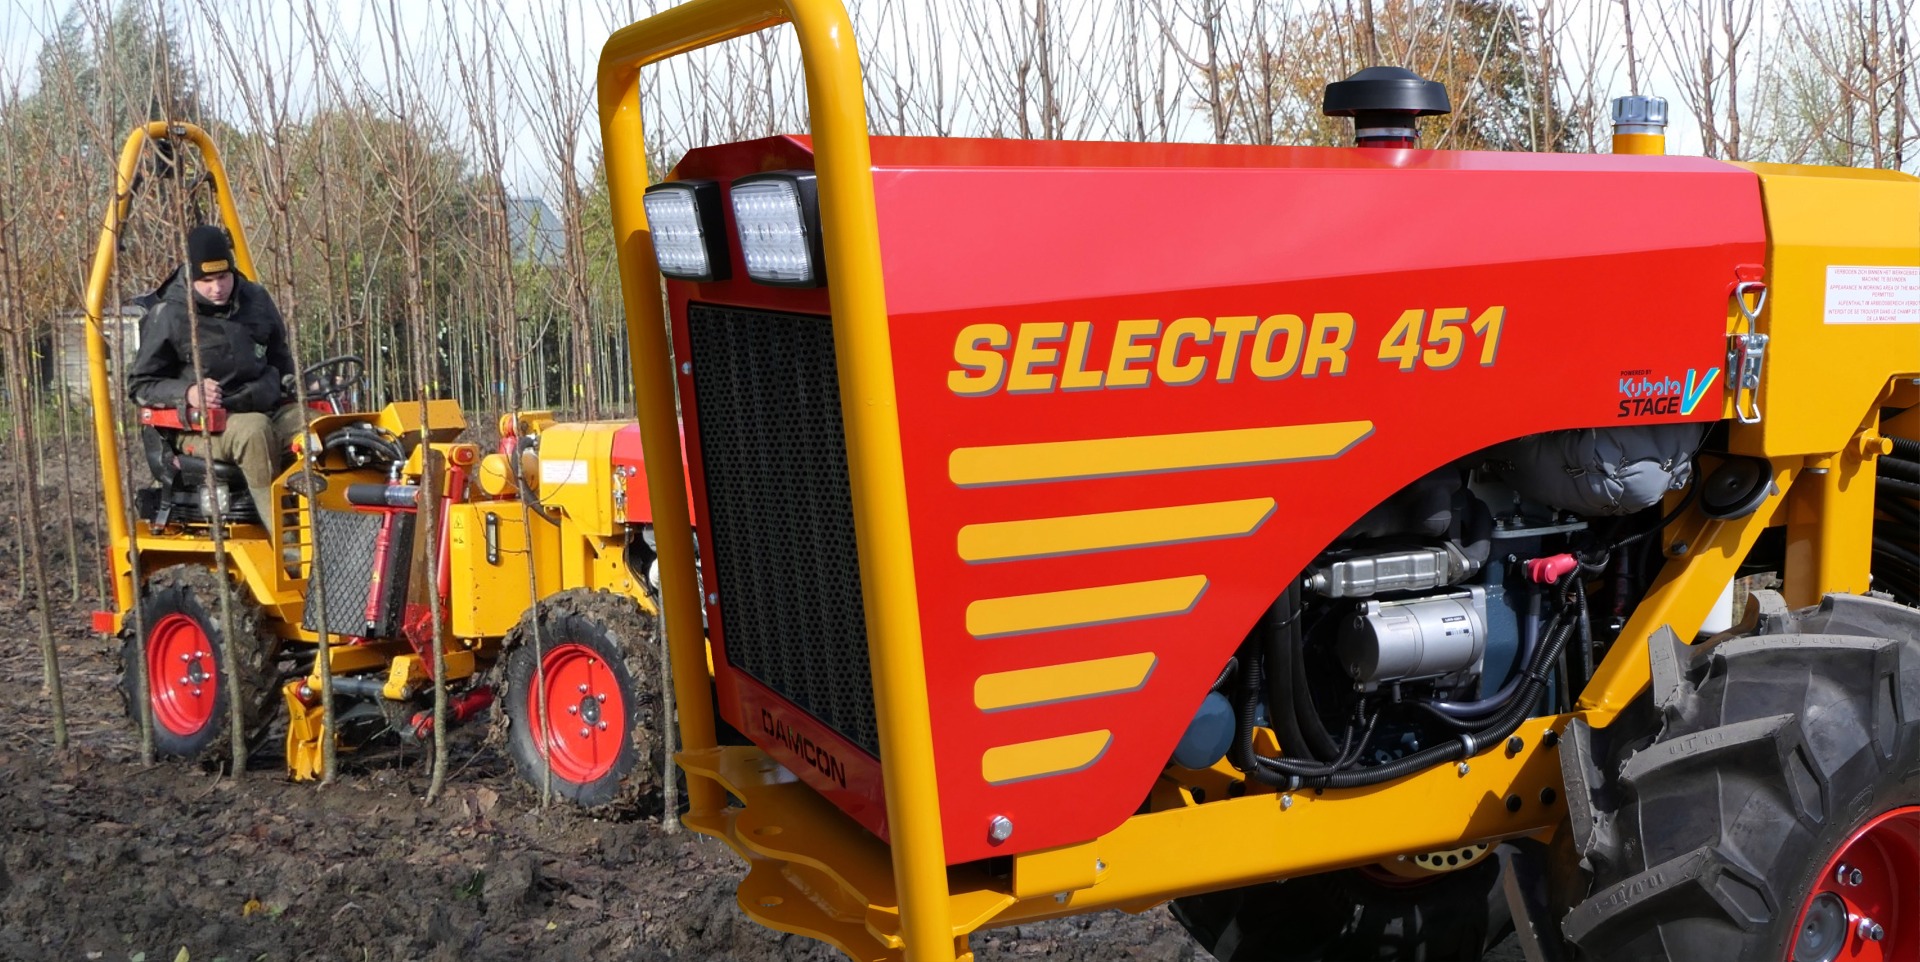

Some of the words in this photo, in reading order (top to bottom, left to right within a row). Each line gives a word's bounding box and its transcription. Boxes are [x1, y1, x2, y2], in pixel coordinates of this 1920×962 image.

[947, 312, 1355, 397] SELECTOR
[1377, 305, 1505, 371] 451
[1617, 397, 1680, 418] STAGE
[1680, 367, 1720, 415] V
[1619, 376, 1681, 397] Kubota
[762, 708, 846, 789] DAMCON
